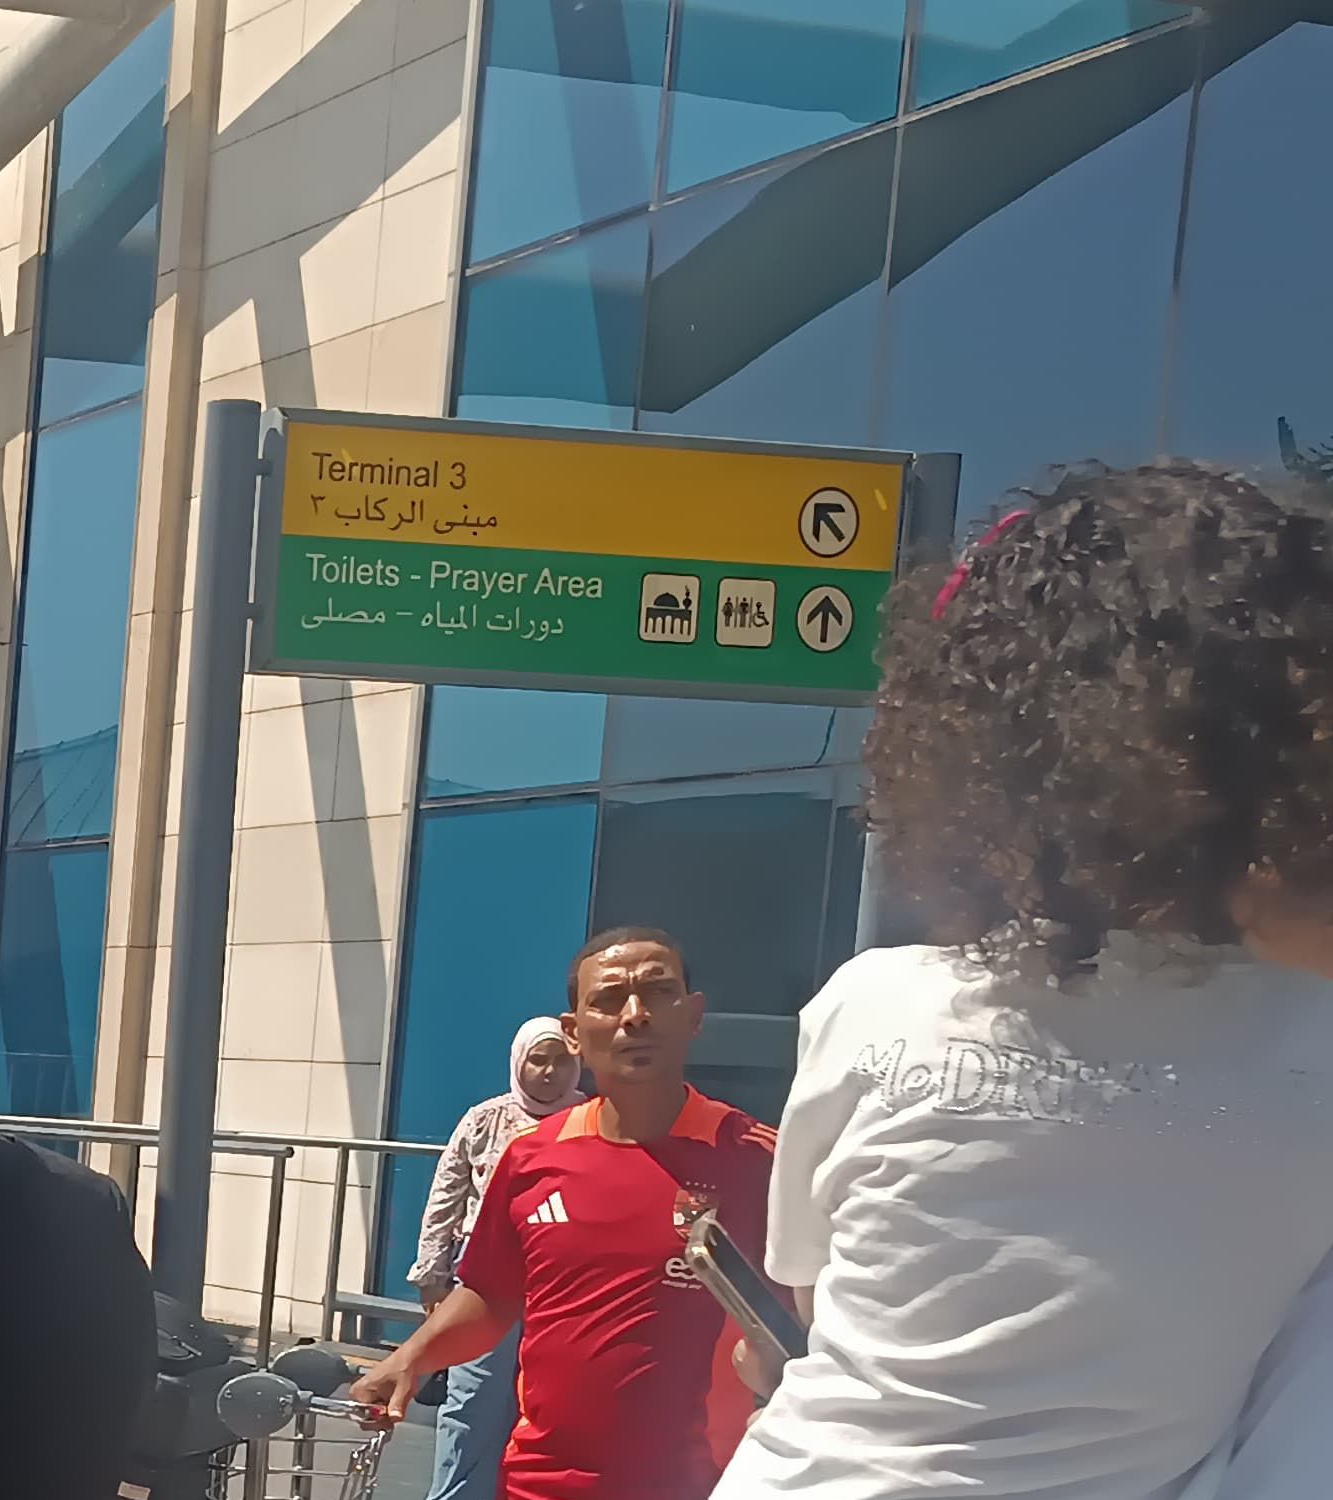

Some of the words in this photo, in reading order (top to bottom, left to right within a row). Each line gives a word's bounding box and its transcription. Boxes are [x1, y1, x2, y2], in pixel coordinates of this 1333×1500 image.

[312, 452, 439, 488] Terminal
[449, 461, 467, 490] 3
[310, 494, 326, 516] ٣
[334, 494, 425, 531] الركاب
[433, 504, 498, 536] مبنى
[306, 552, 400, 587] Toilets
[430, 560, 528, 599] Prayer
[533, 567, 604, 599] Area
[301, 597, 387, 630] مصلى
[420, 601, 478, 635] المياه
[486, 606, 565, 641] دورات
